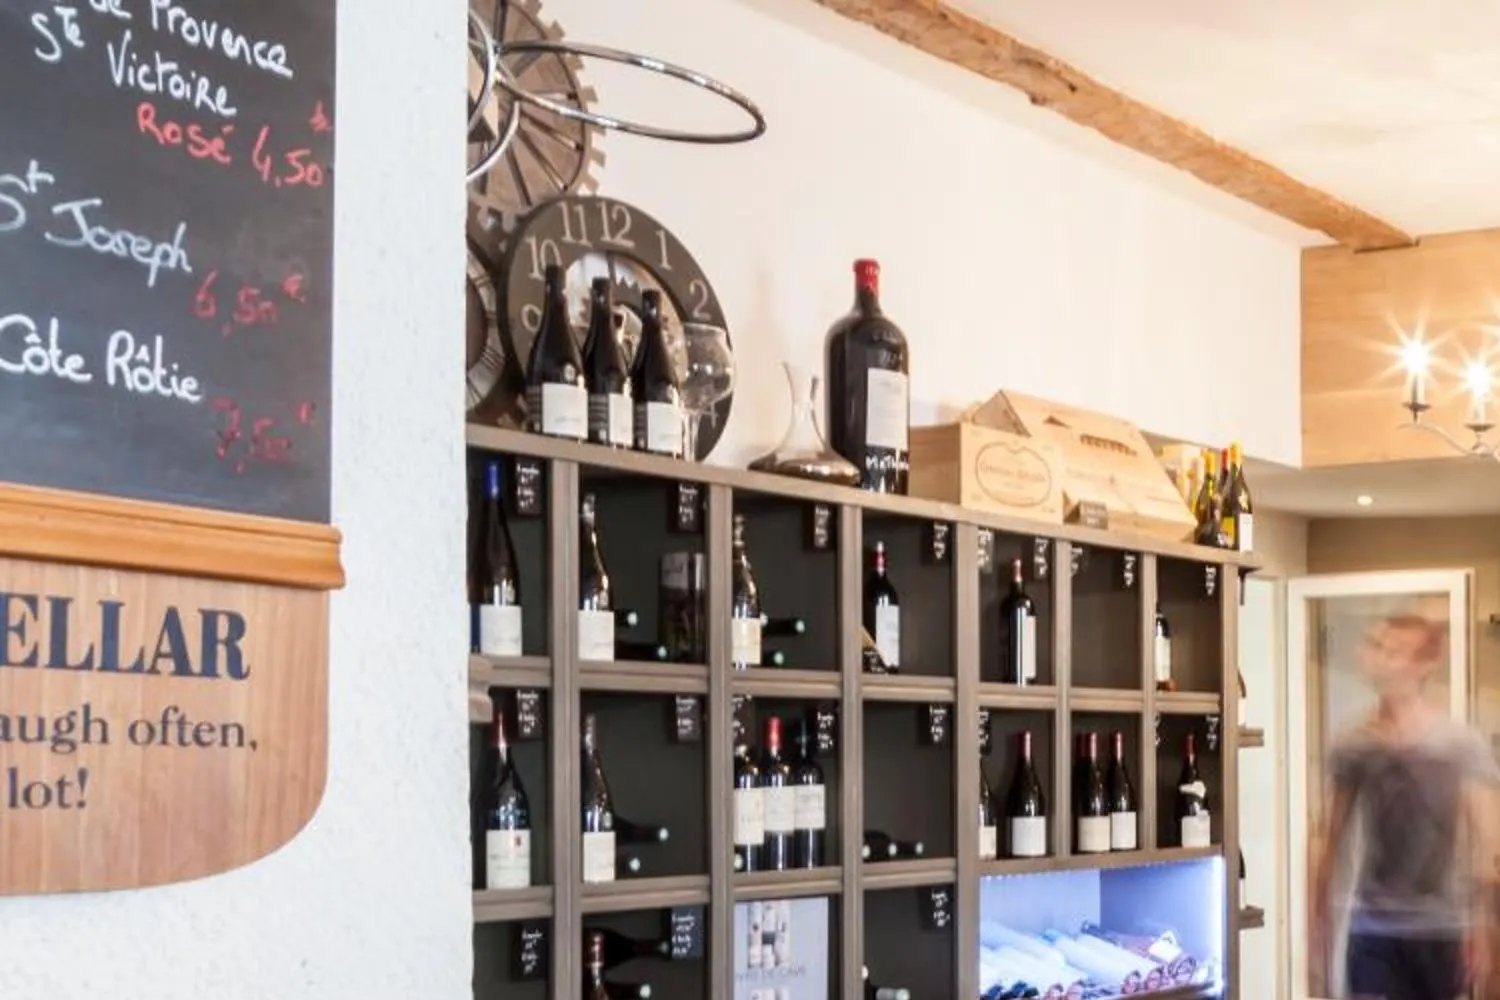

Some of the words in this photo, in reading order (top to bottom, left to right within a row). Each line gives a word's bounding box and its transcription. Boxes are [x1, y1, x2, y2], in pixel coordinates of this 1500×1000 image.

[45, 198, 193, 287] Joseph
[558, 200, 593, 248] 11
[599, 201, 635, 248] 12
[656, 230, 672, 270] 1
[689, 278, 711, 321] 2
[0, 313, 93, 382] Côte
[106, 330, 202, 403] Rôtie
[128, 704, 258, 751] often,
[8, 766, 89, 809] lot!
